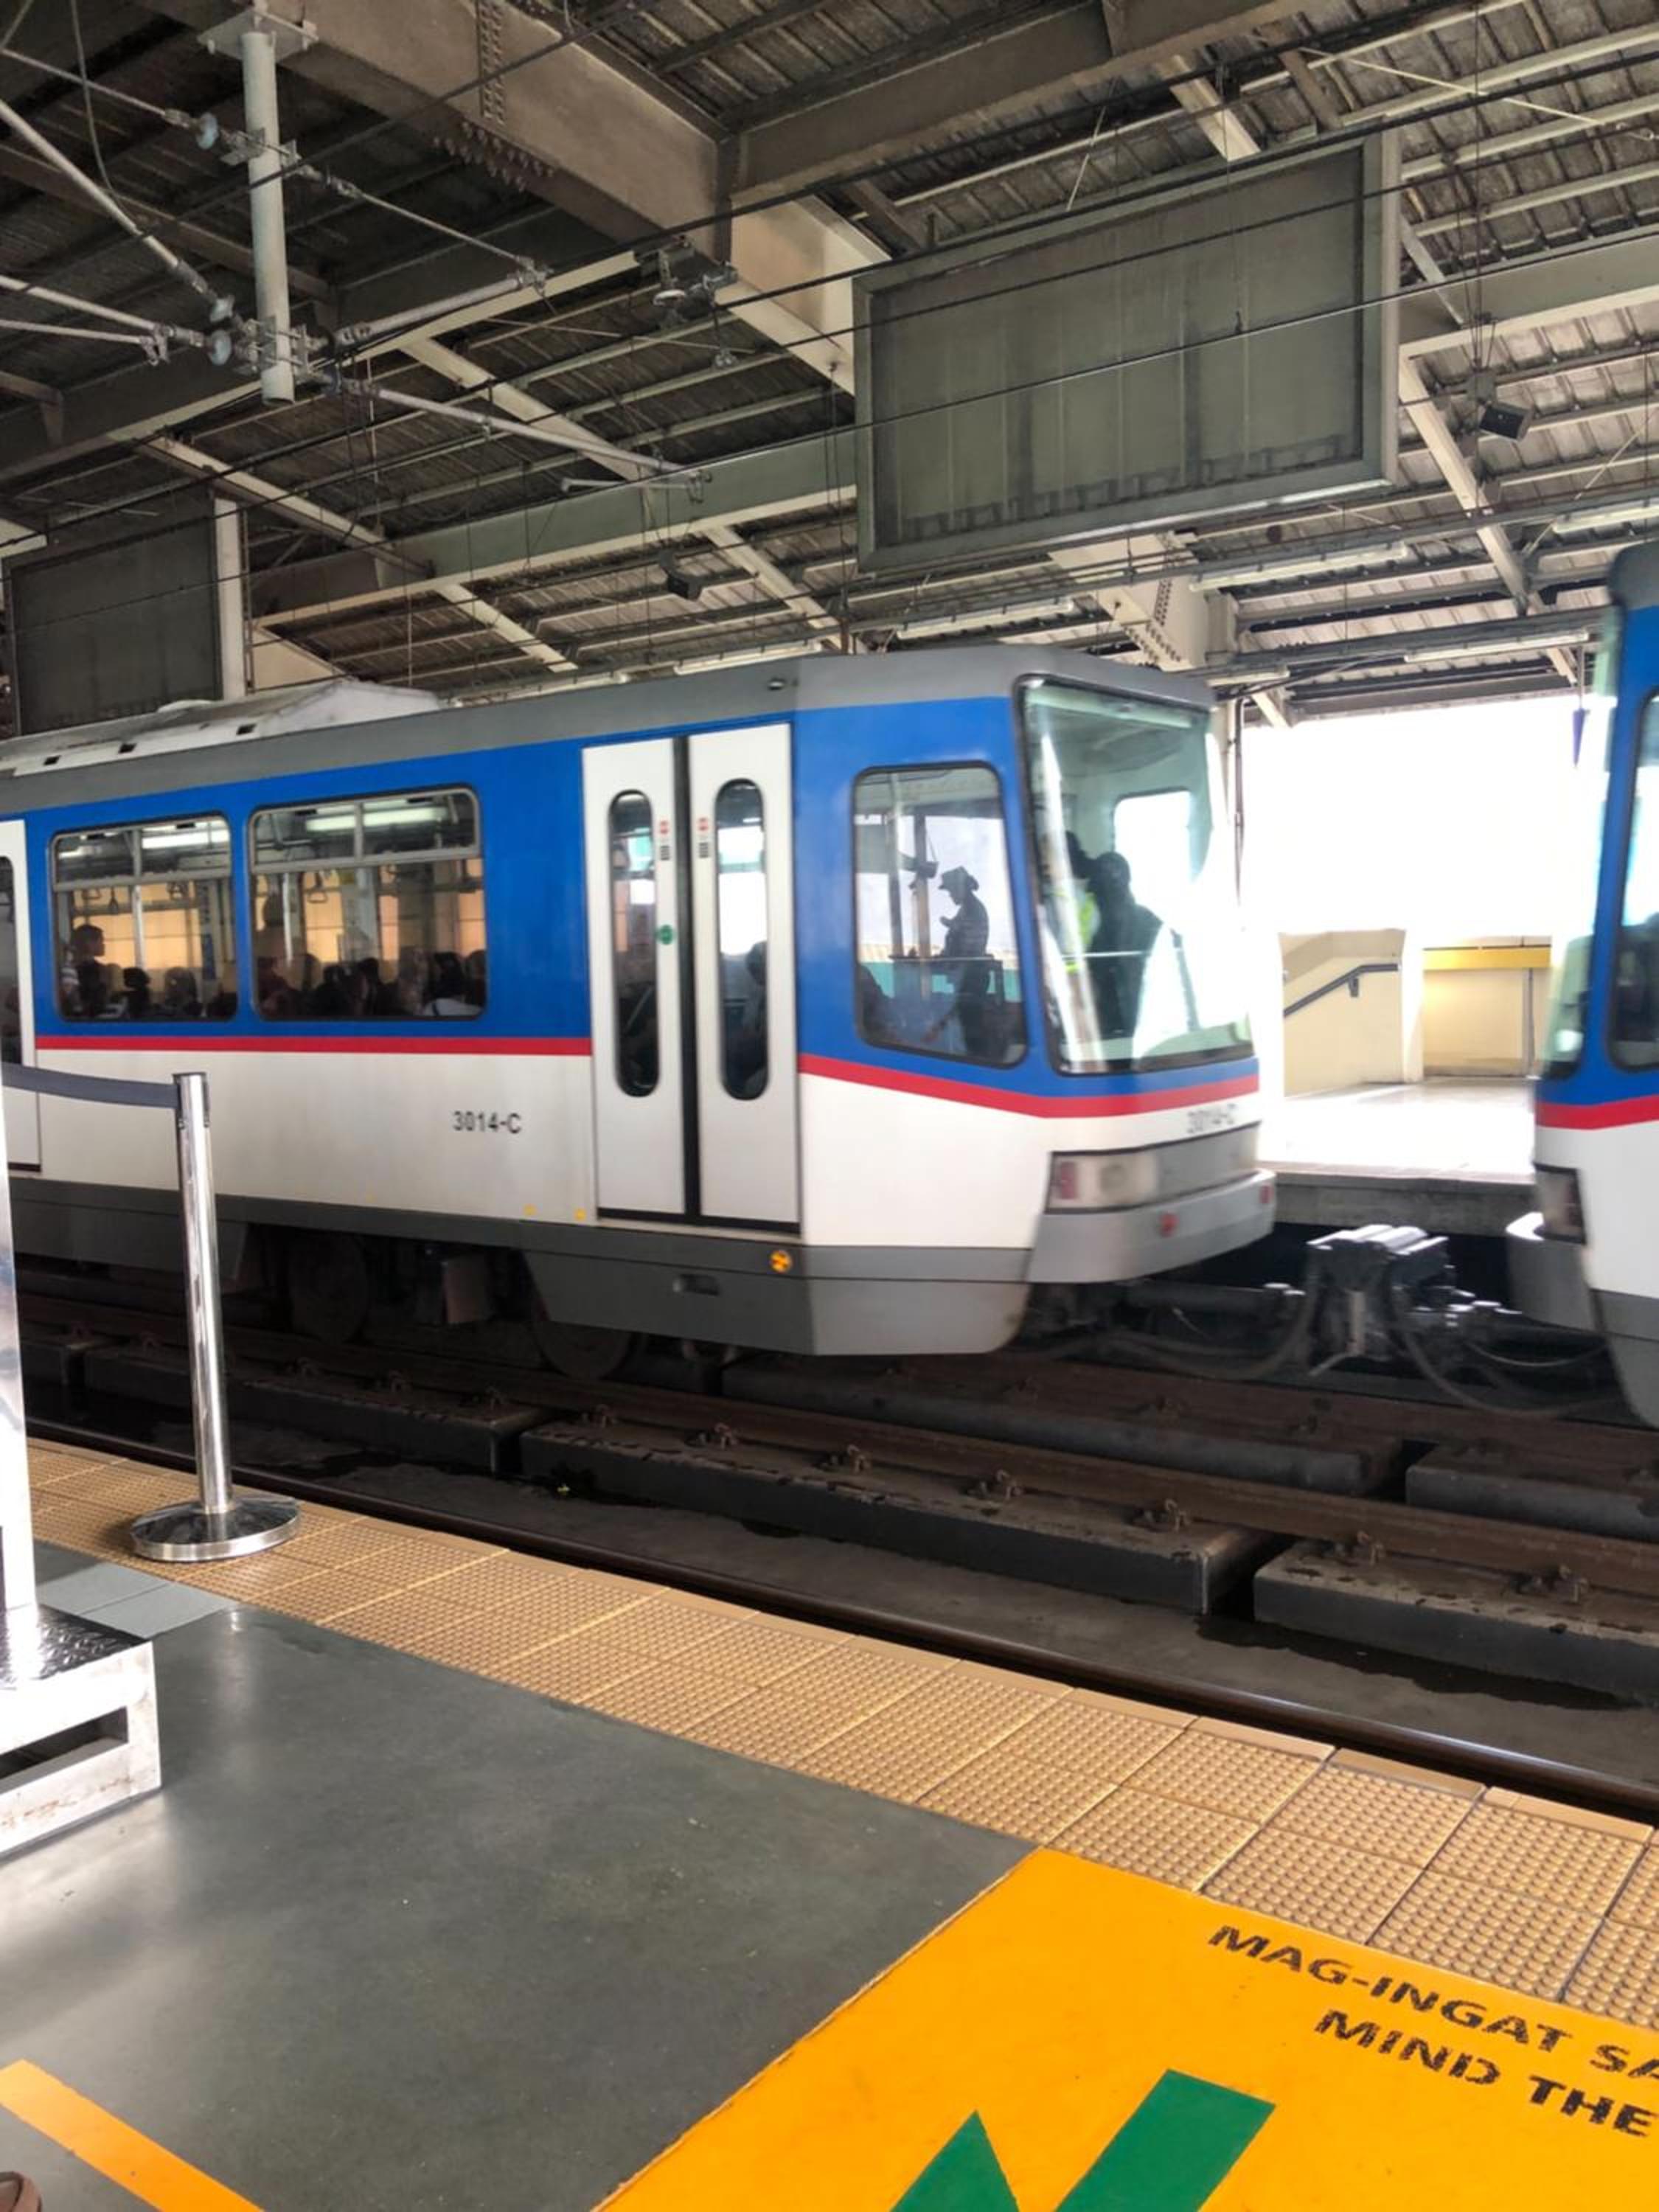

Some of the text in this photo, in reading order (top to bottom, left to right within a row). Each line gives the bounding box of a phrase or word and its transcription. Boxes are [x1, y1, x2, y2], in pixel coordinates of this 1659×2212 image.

[453, 1110, 522, 1134] 3014-C
[1208, 1925, 1573, 2053] MAG-INGAT
[1314, 2010, 1659, 2138] MIND THE
